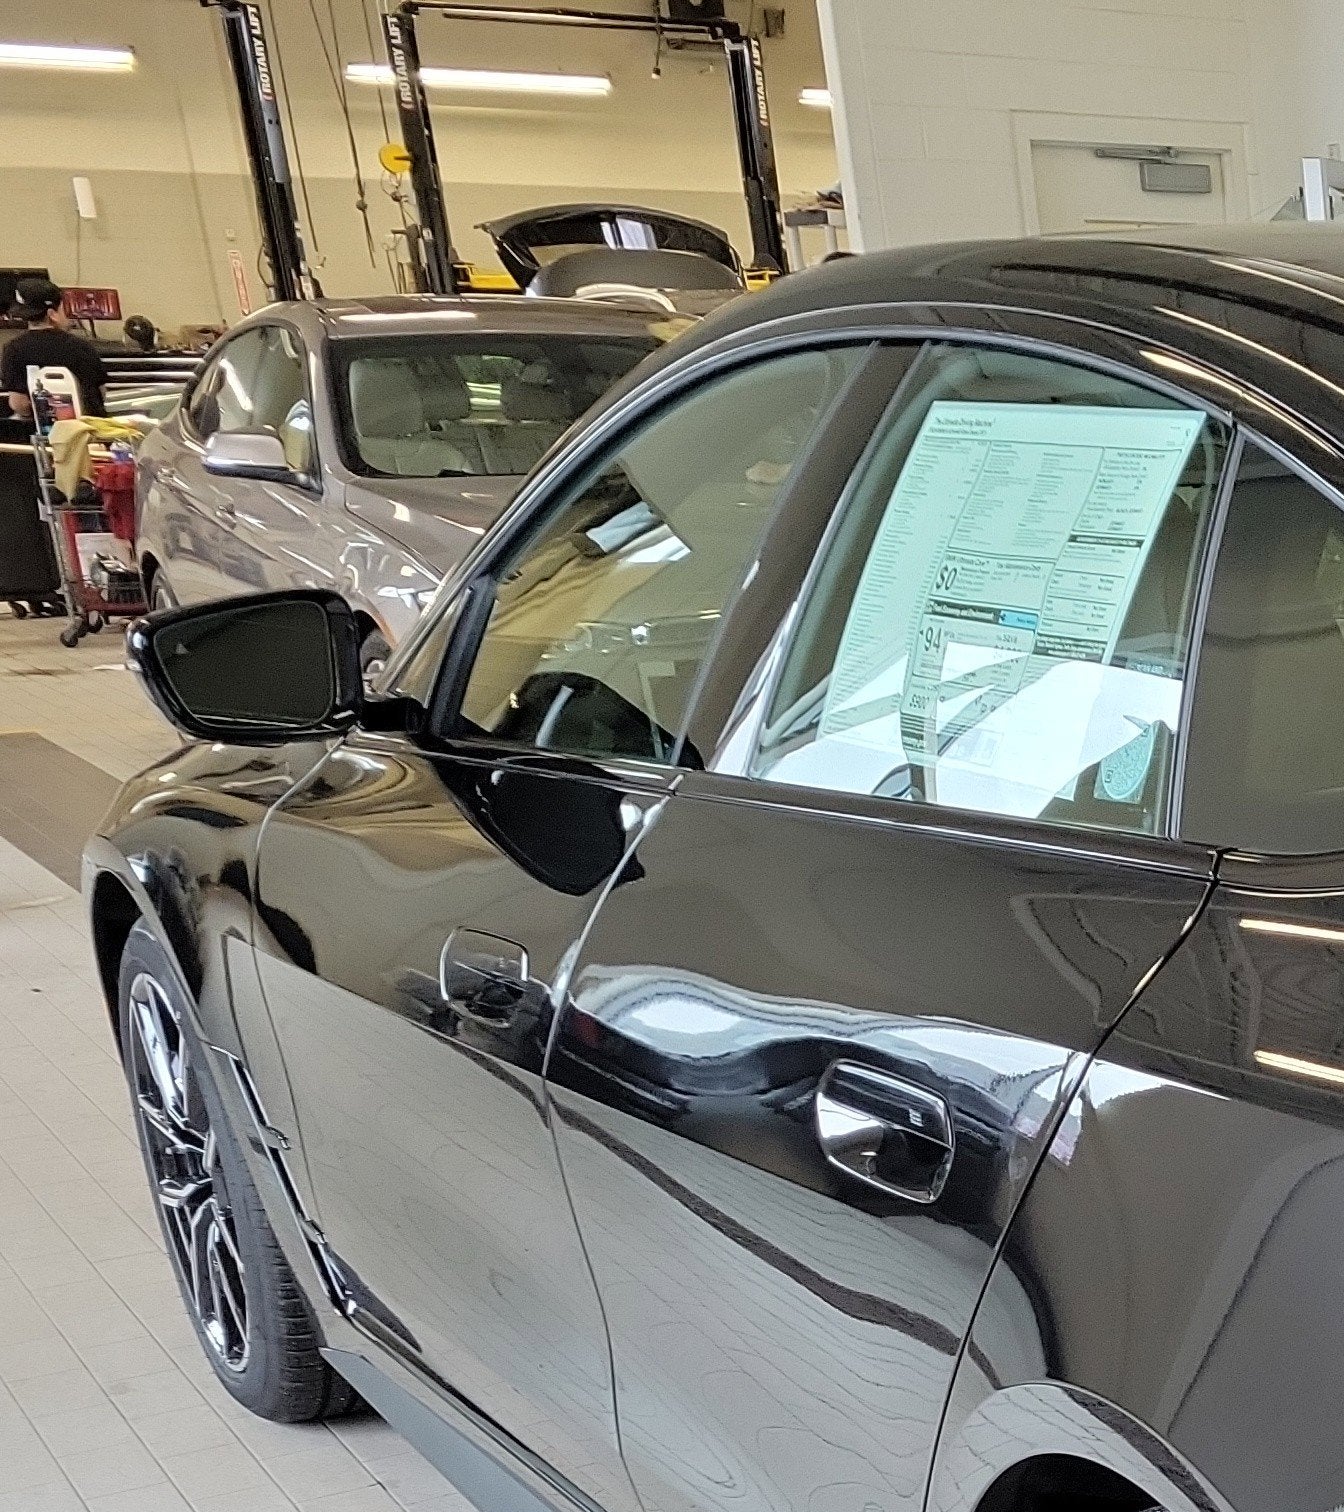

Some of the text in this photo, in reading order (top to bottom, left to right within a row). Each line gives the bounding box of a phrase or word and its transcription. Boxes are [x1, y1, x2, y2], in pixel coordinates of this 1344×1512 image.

[247, 5, 272, 93] ROTARY LIFT
[386, 15, 403, 43] LIFT
